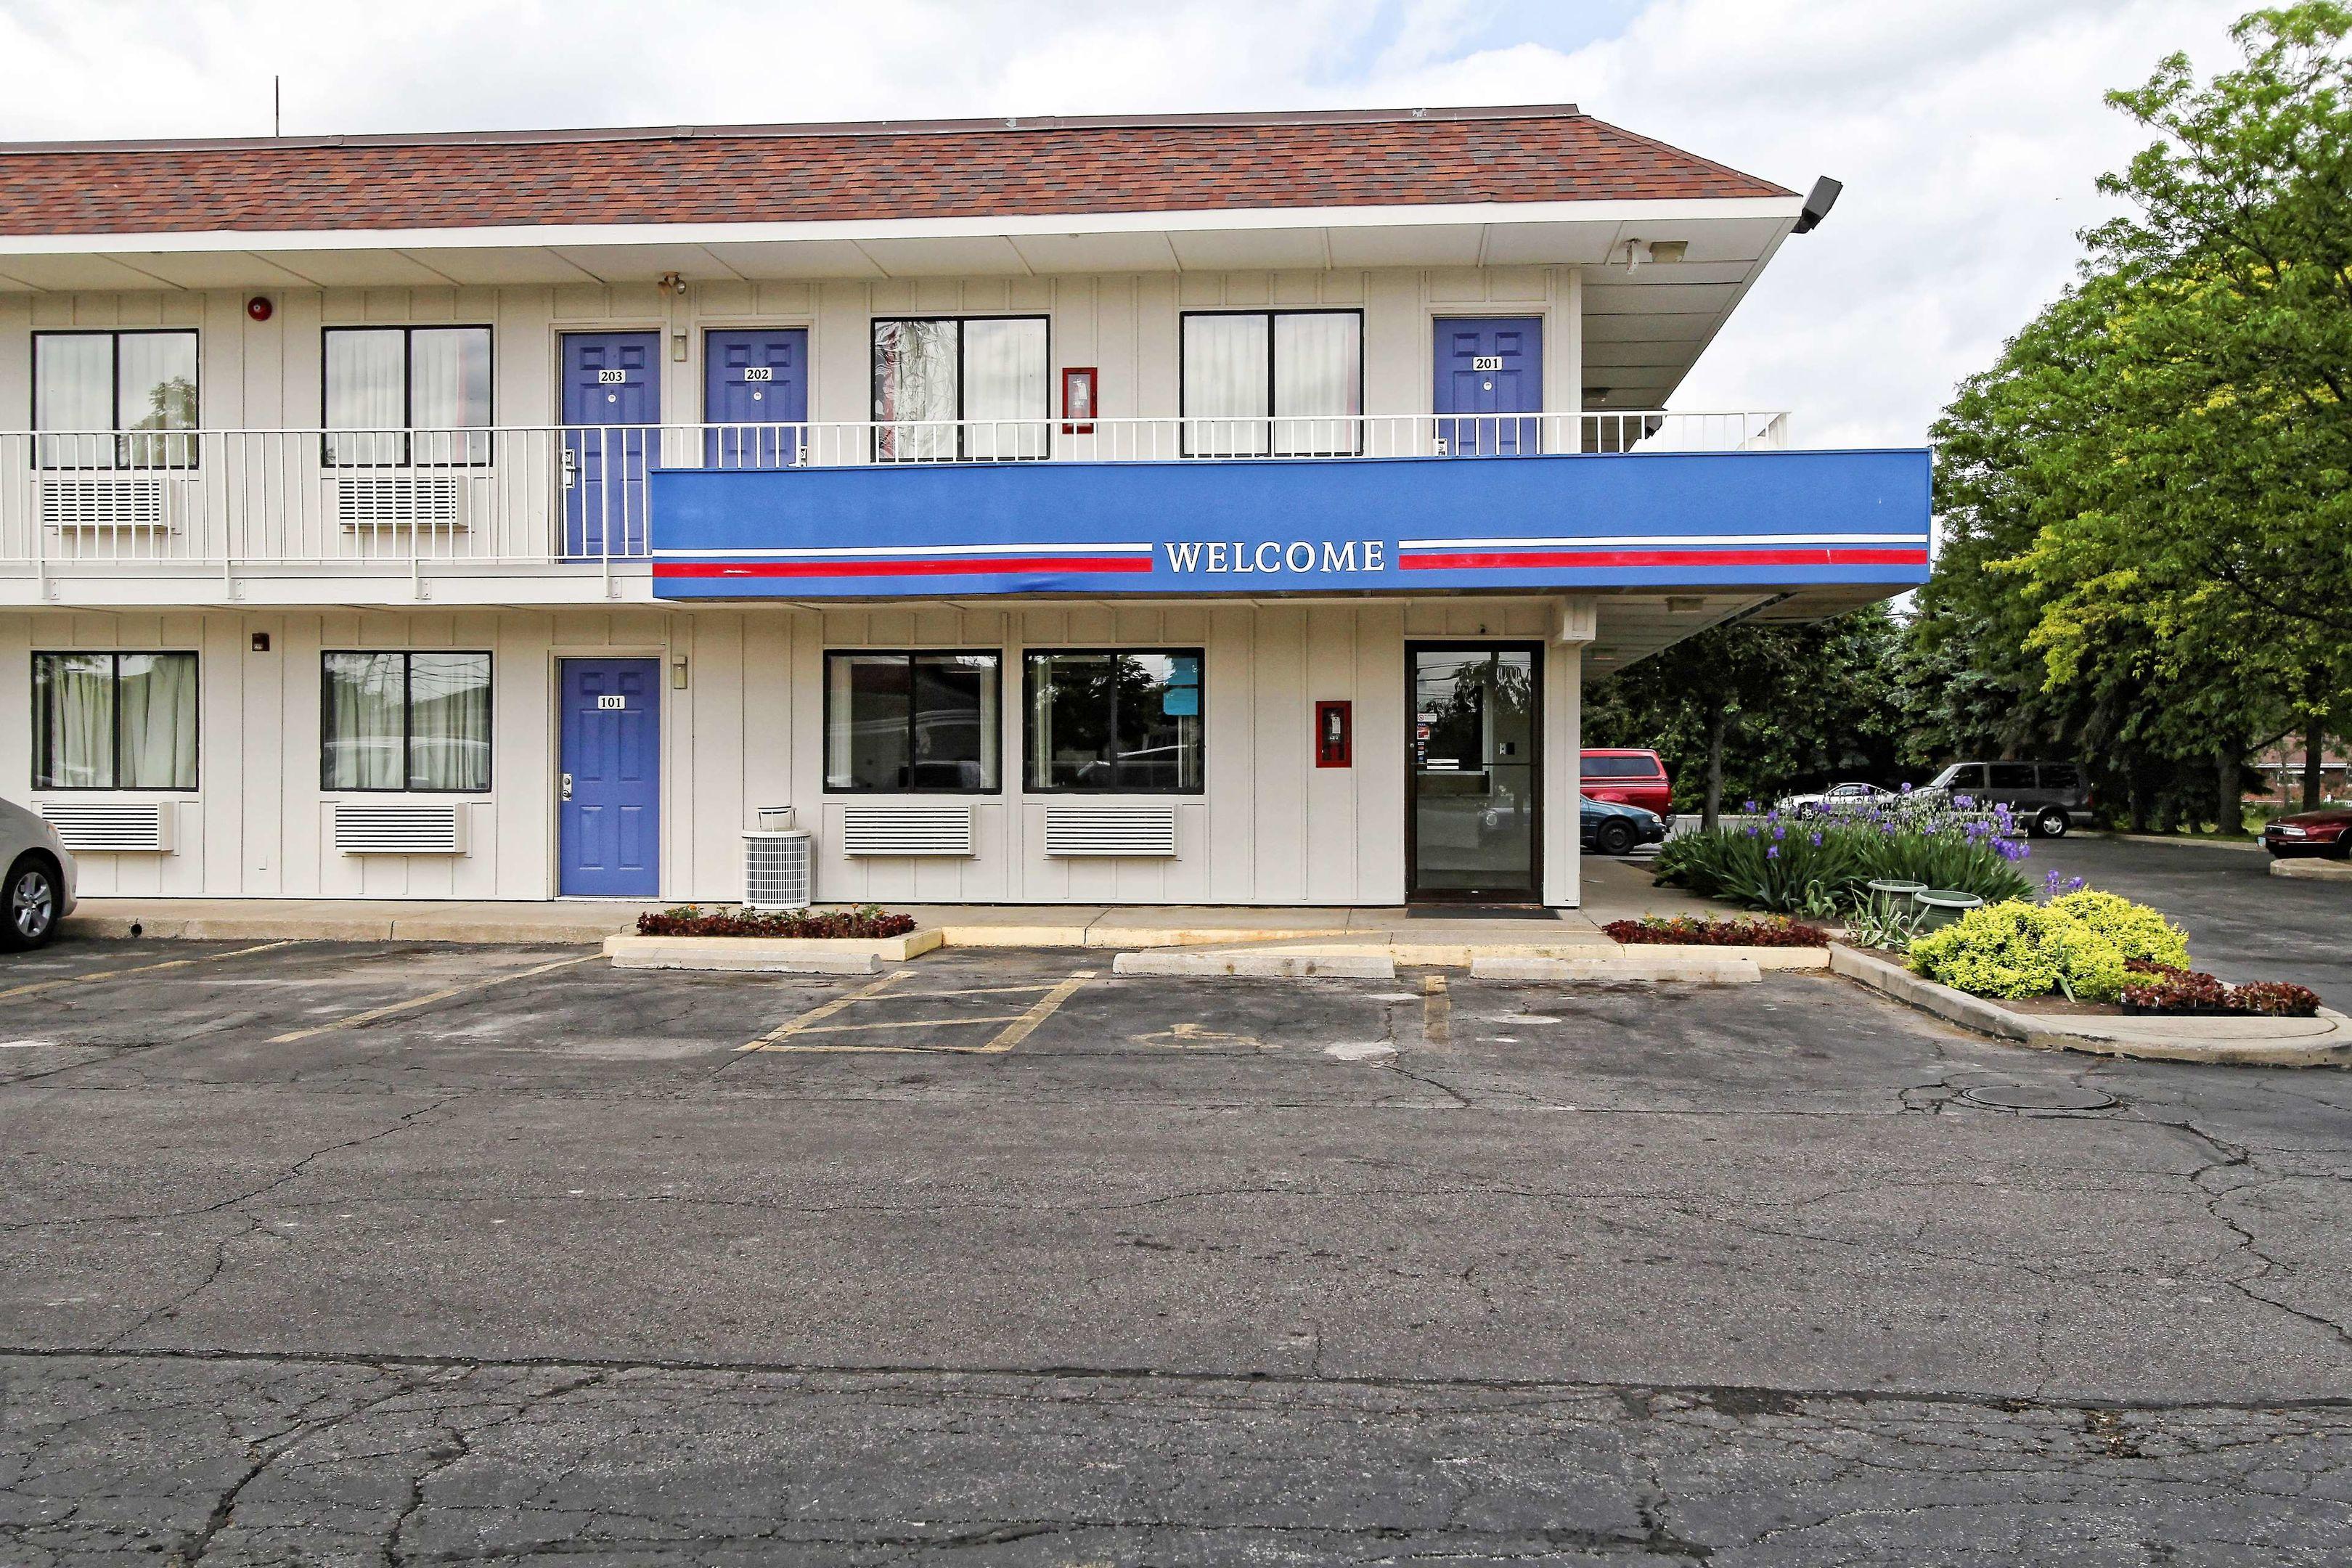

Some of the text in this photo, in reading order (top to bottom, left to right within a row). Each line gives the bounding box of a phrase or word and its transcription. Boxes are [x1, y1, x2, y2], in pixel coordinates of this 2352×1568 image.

[1476, 359, 1498, 369] 201
[601, 371, 622, 381] 203
[747, 369, 769, 379] 202
[1163, 540, 1386, 573] WELCOME
[601, 698, 621, 708] 101
